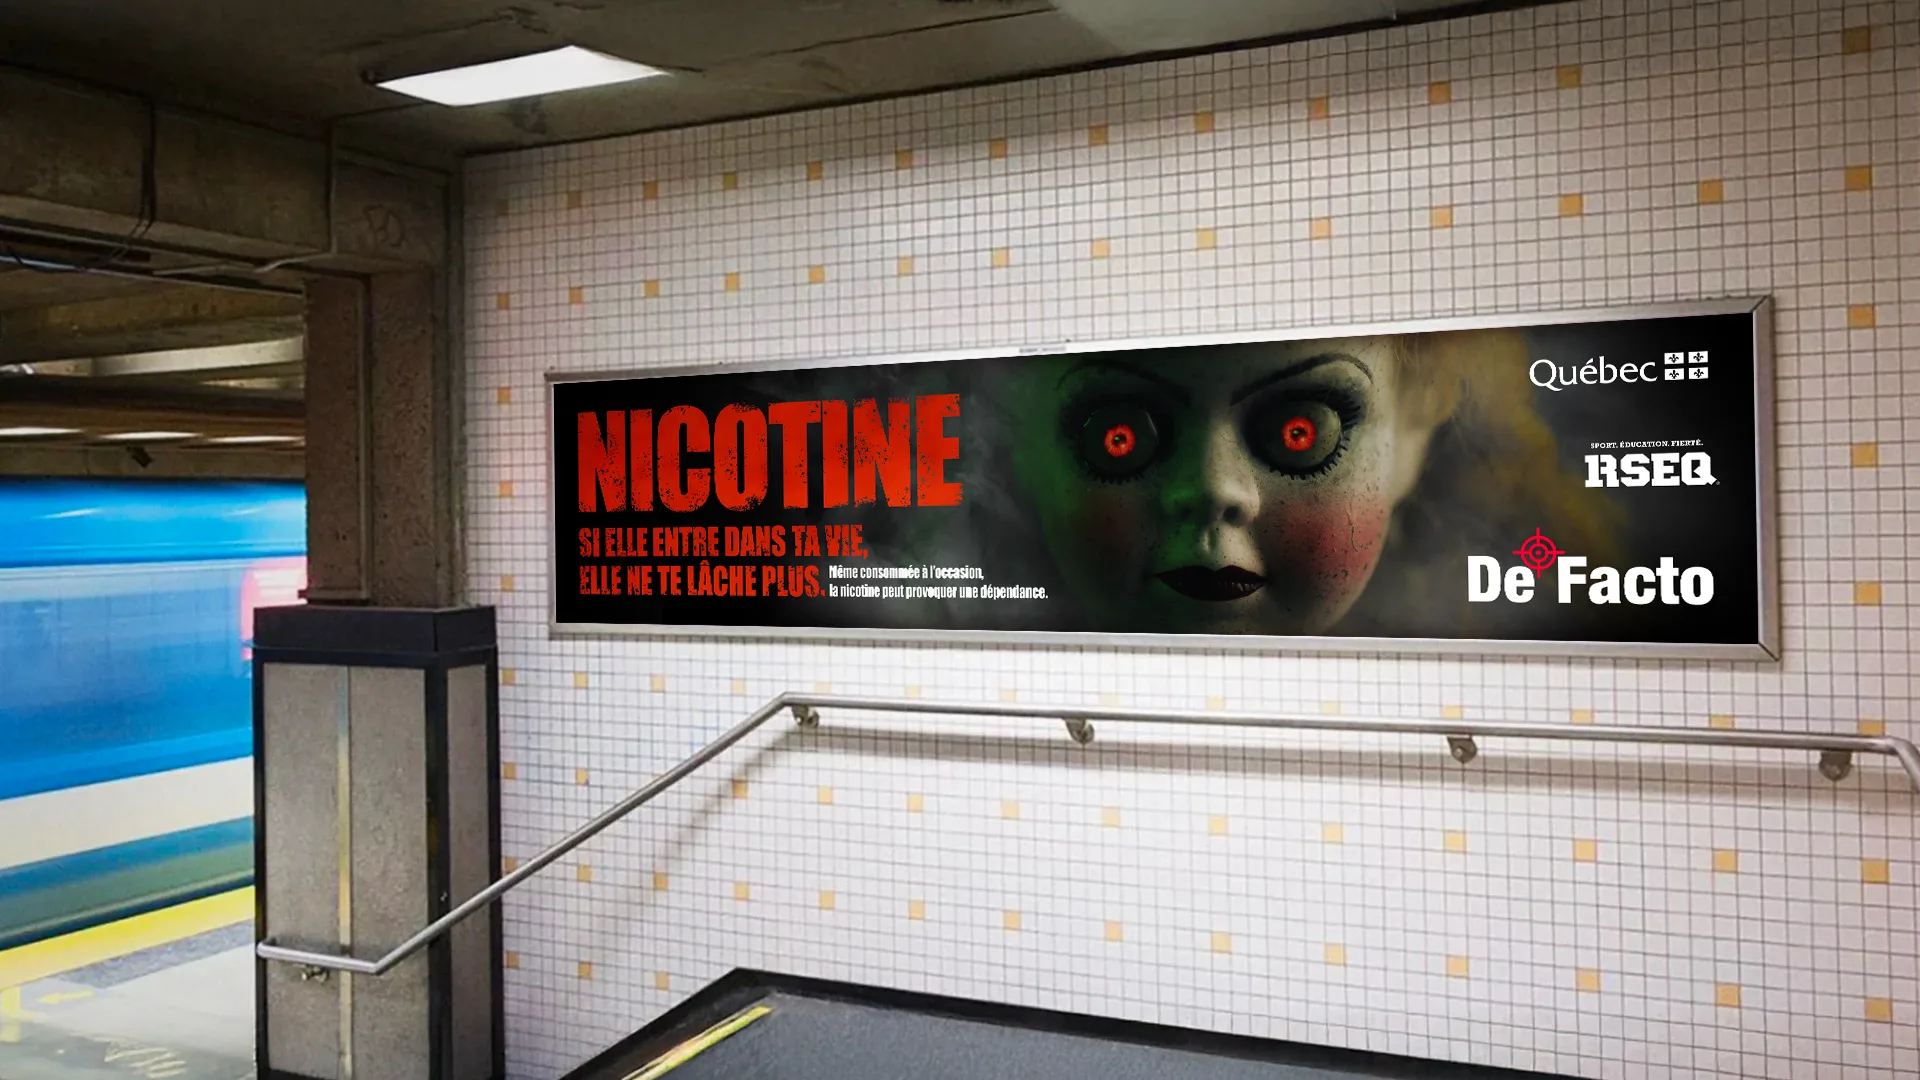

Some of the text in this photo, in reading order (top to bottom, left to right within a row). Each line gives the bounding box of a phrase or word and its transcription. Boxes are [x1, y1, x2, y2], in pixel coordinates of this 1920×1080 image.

[1529, 356, 1658, 392] Québec
[577, 393, 964, 514] NICOTINE
[1620, 440, 1670, 448] ÉDUCATION.
[1671, 438, 1704, 447] FIERTÉ.
[1584, 451, 1718, 488] RSEQ
[578, 524, 869, 560] SI ELLE ENTRE DANS TA VIE,
[579, 560, 826, 597] ELLE NE TE LÂCHE PLUS.
[829, 565, 858, 579] Même
[860, 565, 920, 579] consommée
[922, 565, 929, 579] à
[1467, 555, 1715, 605] De Facto
[829, 584, 1049, 599] la nicotine peut provoquer une dépendance.
